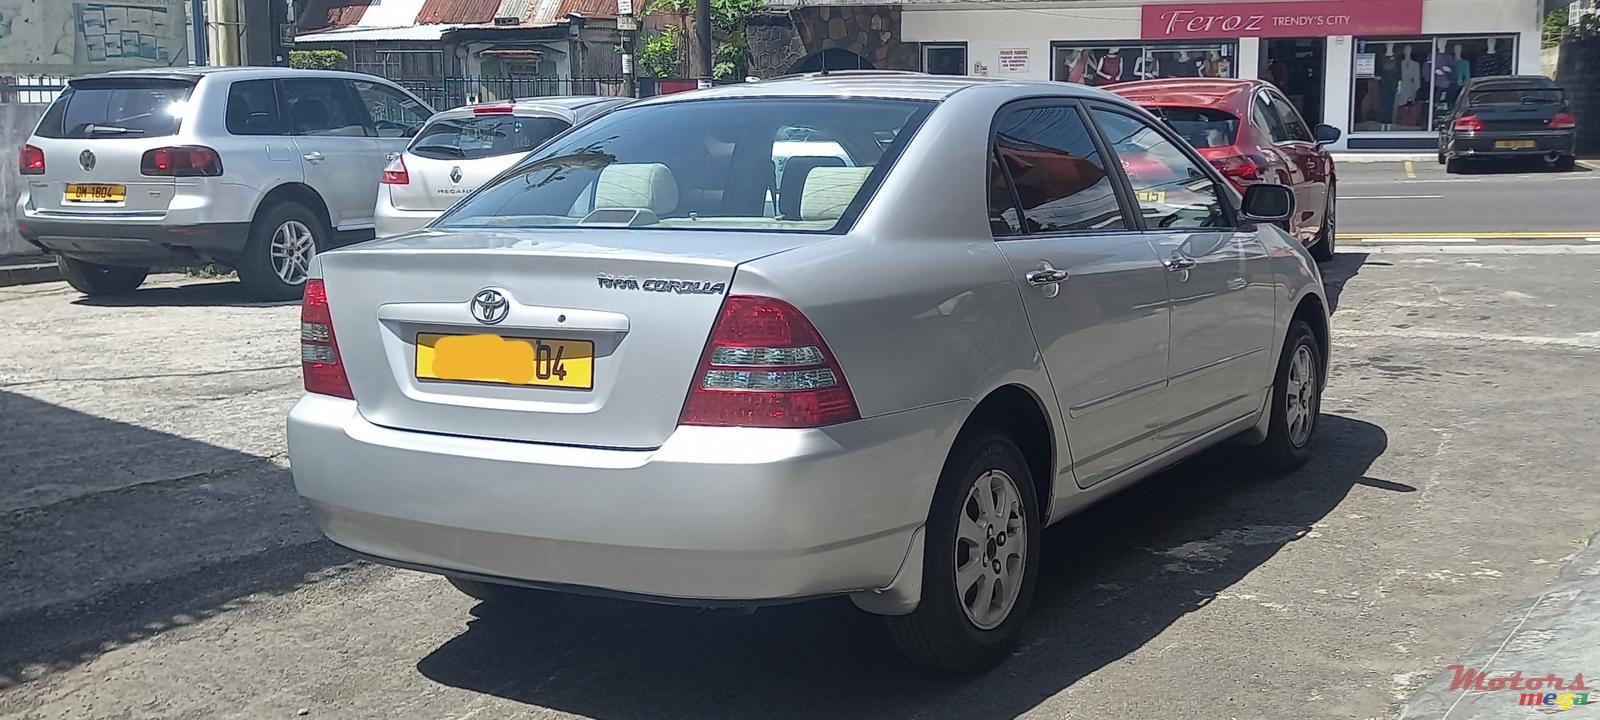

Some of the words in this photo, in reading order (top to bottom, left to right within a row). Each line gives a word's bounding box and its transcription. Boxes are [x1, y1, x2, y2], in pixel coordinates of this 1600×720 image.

[1160, 9, 1264, 35] Feroz
[1272, 15, 1324, 27] TRENDY'S
[1326, 15, 1351, 25] CITY
[596, 277, 640, 291] TOYOTA
[642, 279, 726, 295] COROLLA
